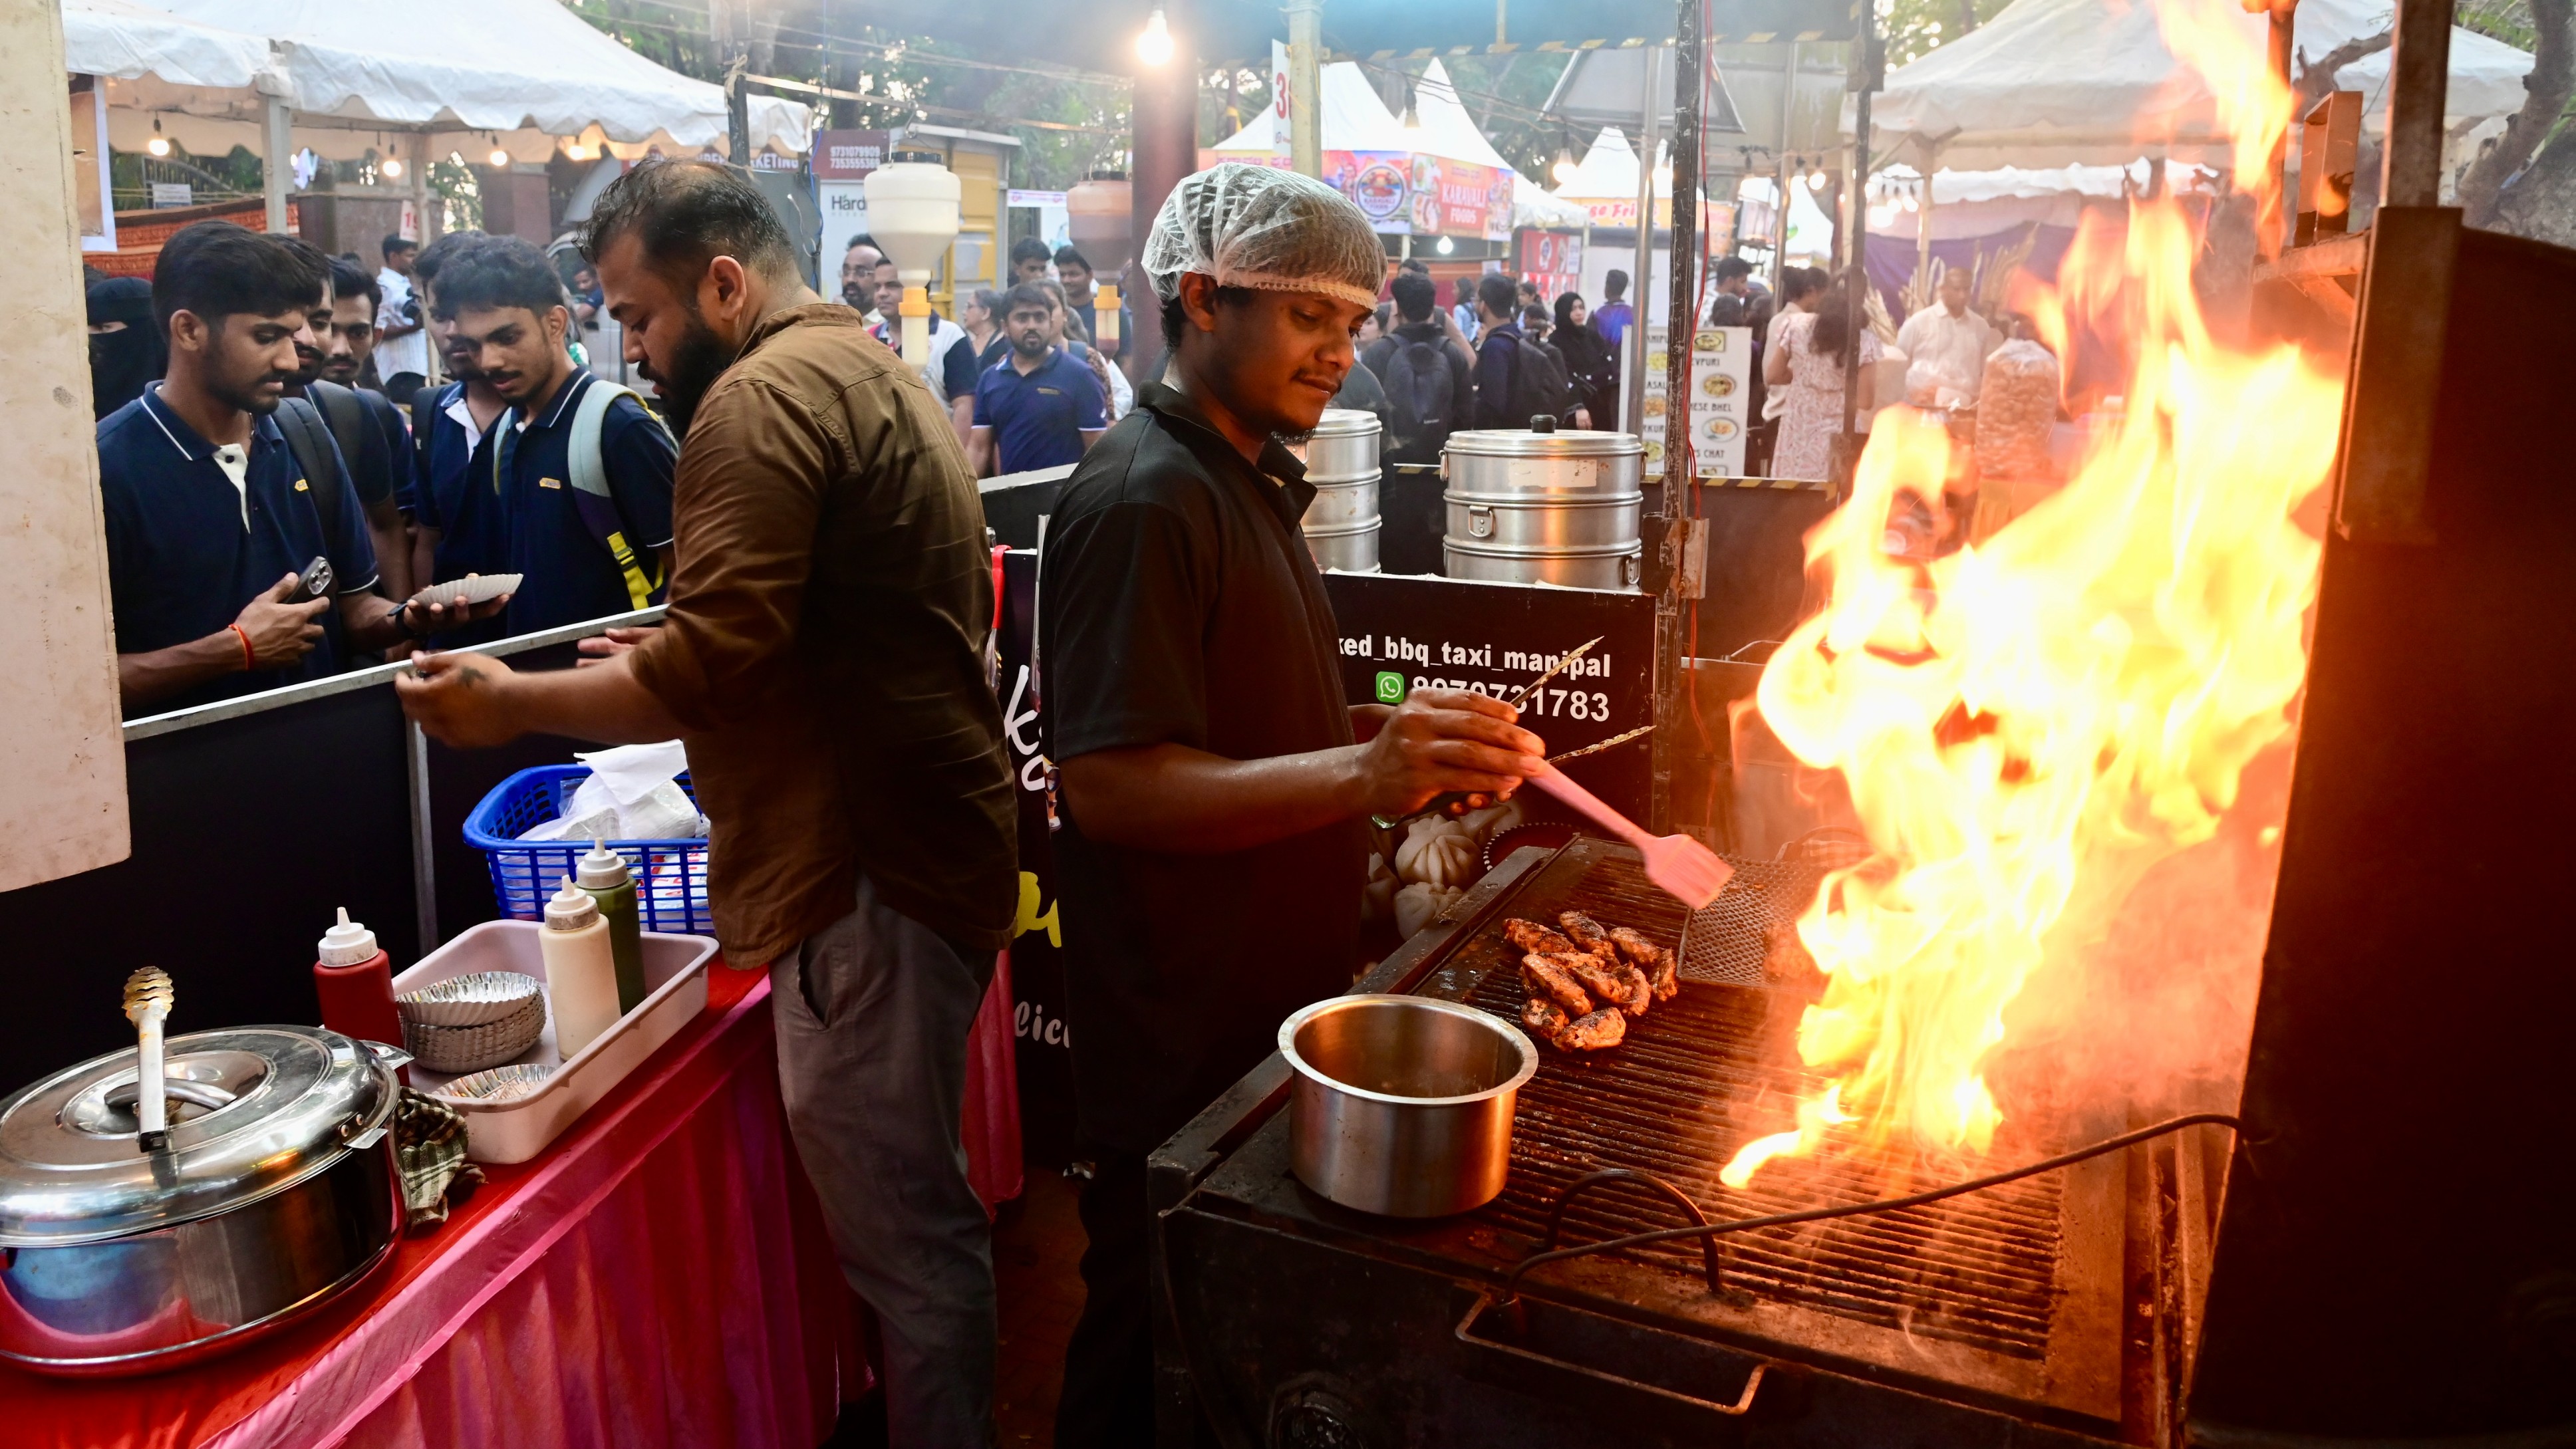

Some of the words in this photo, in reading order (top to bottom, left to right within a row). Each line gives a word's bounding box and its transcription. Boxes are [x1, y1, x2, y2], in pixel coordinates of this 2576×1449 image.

[1441, 183, 1487, 208] KARAVALI
[1450, 207, 1477, 225] FOODS
[1711, 403, 1733, 412] BHEL
[1703, 450, 1725, 458] CHAT
